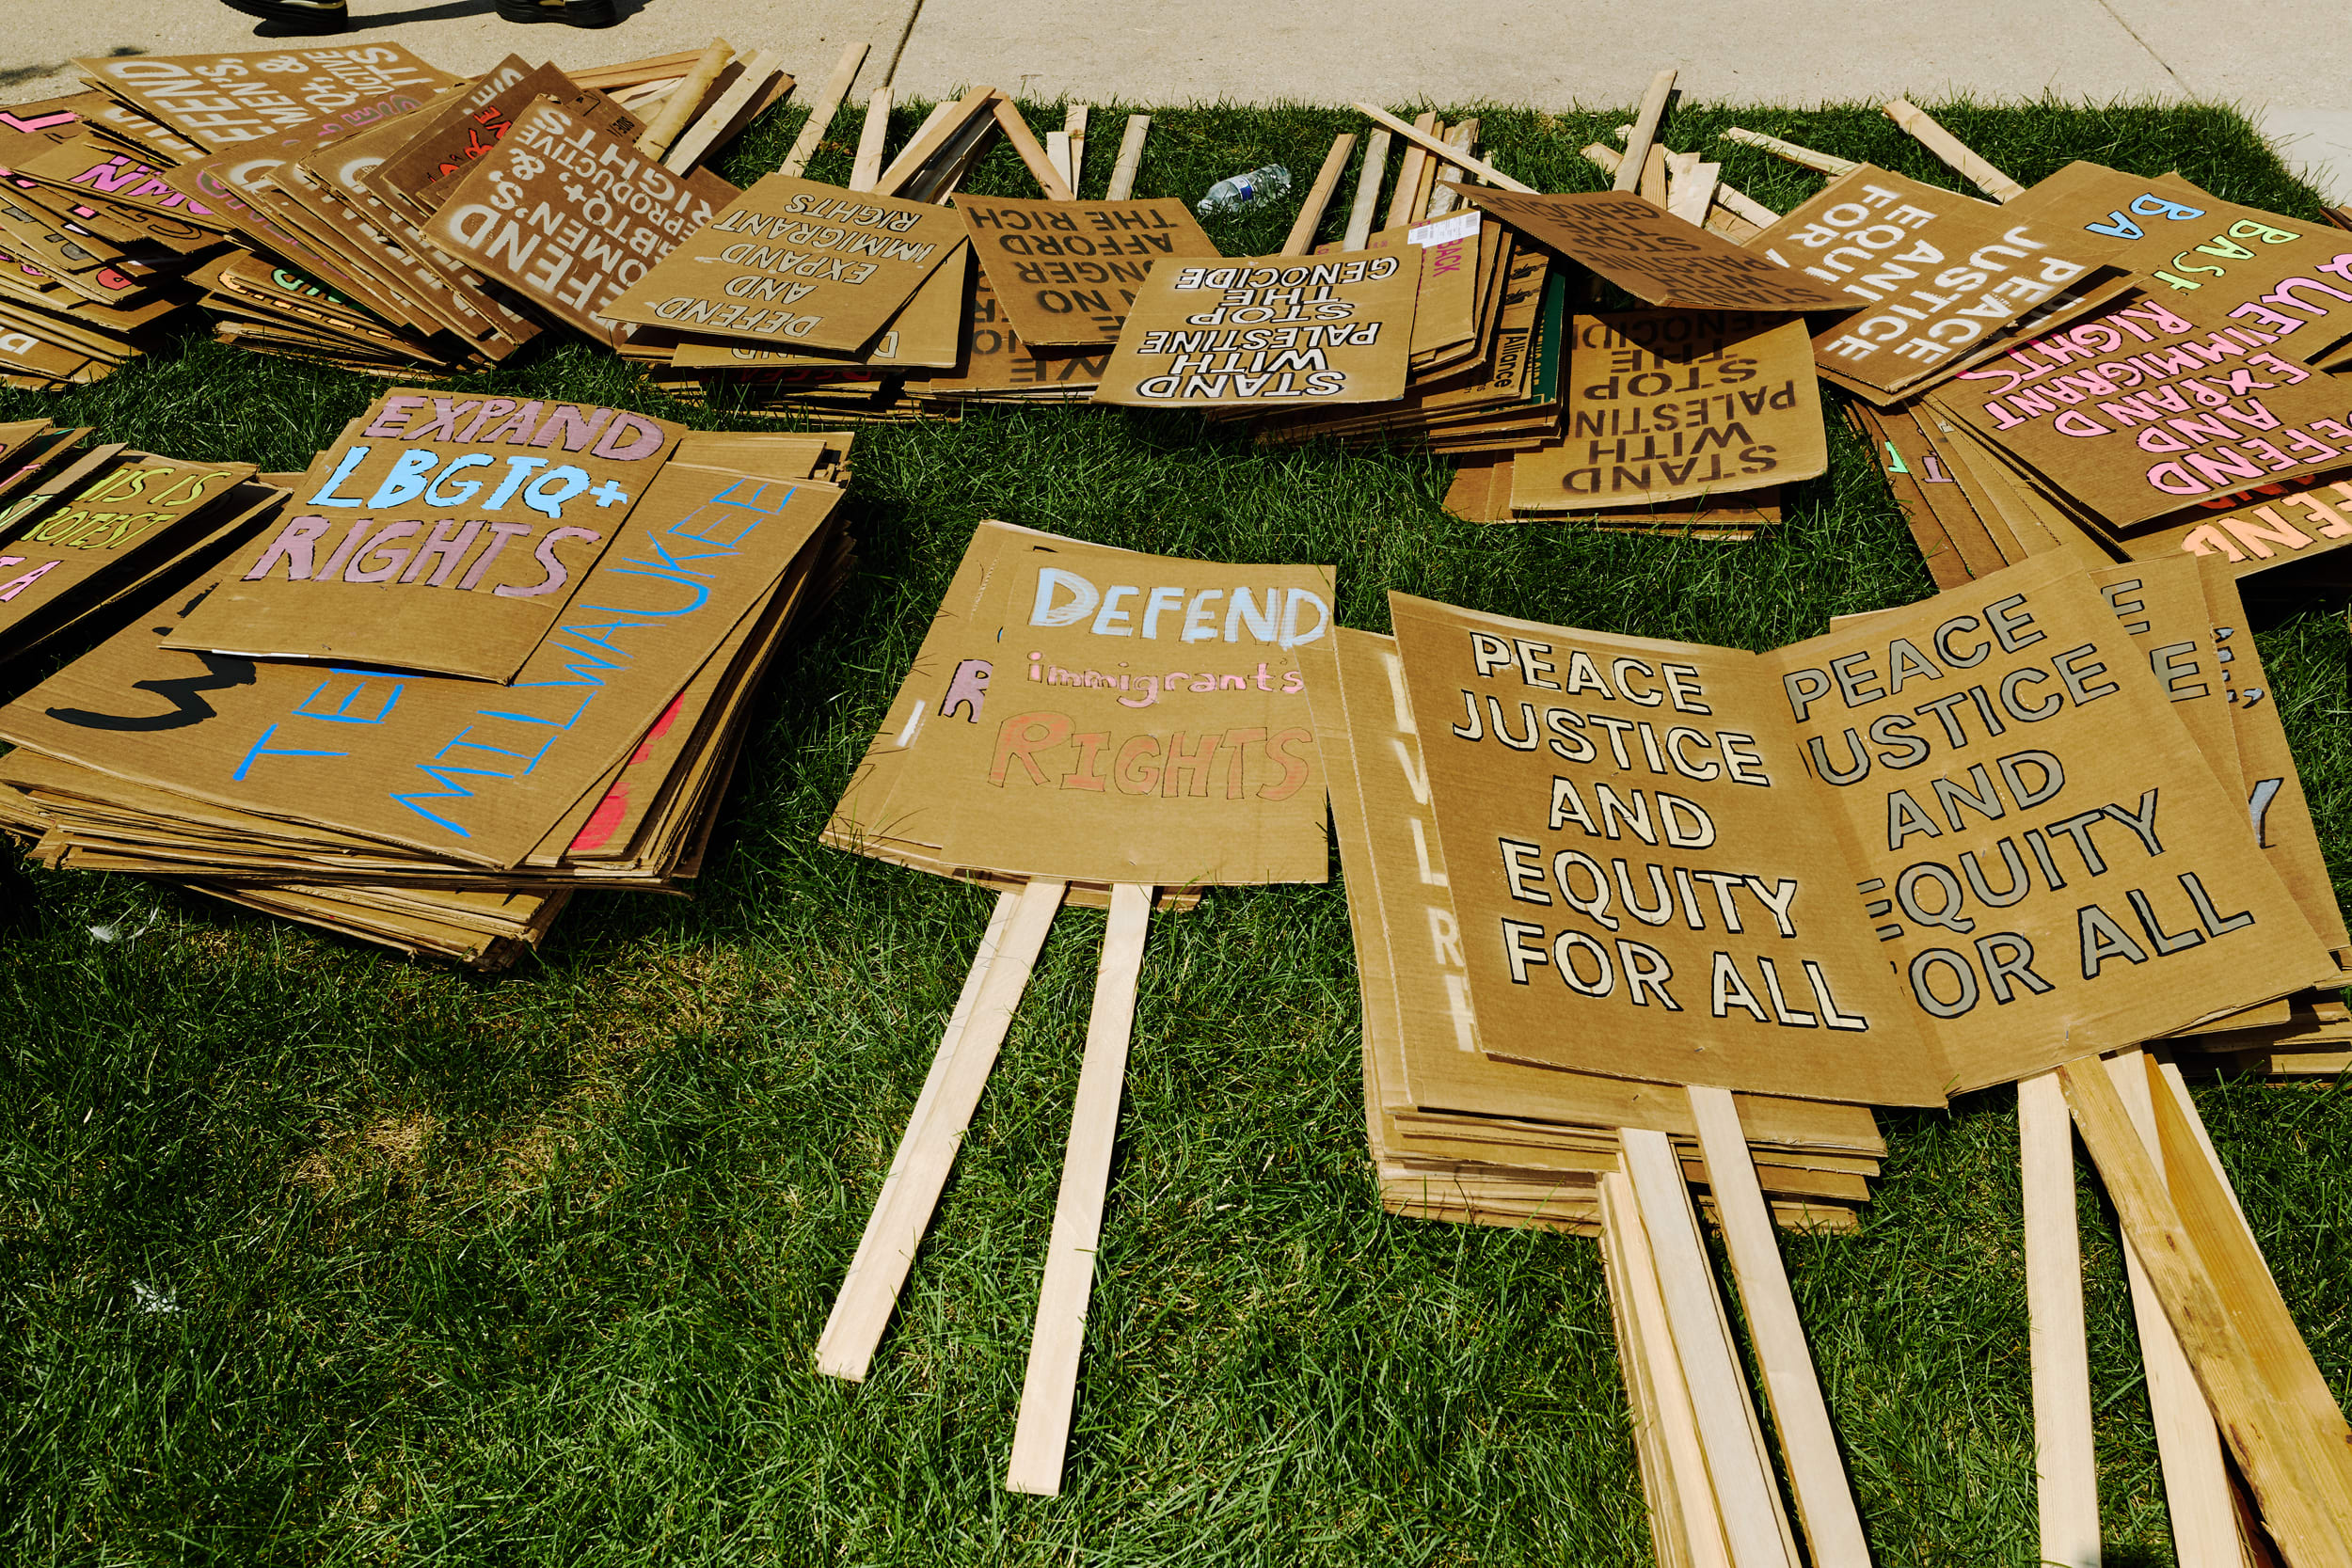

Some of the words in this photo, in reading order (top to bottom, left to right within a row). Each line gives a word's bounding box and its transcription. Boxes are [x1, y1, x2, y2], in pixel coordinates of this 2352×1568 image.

[255, 55, 310, 73] &
[105, 60, 276, 143] EFEND
[508, 148, 546, 182] &
[516, 123, 700, 243] EPRODUCTIVE
[532, 105, 715, 227] RIGHTS
[488, 170, 649, 288] OMEN'S,
[784, 194, 924, 233] RIGHTS
[967, 206, 1079, 232] RICH
[1084, 208, 1179, 231] THE
[1479, 193, 1662, 222] GENOCIDE
[1555, 217, 1661, 239] THE
[1787, 184, 1903, 248] FOR
[2084, 192, 2207, 241] BA
[711, 209, 937, 263] IMMIGRANT
[998, 232, 1175, 257] AFFORD
[1570, 234, 1703, 255] STOP
[1587, 246, 1779, 273] PALESTINE
[1802, 203, 1939, 286] EQUI
[720, 243, 880, 285] EXPAND
[1013, 260, 1155, 285] NGER
[1175, 256, 1400, 290] GENOCIDE
[1640, 271, 1788, 291] WITH
[724, 275, 818, 305] AND
[1035, 290, 1112, 314] NO
[1187, 304, 1356, 325] STOP
[1222, 285, 1343, 307] THE
[1664, 286, 1835, 305] STAND
[1822, 226, 2047, 362] JUSTICE
[1892, 257, 2087, 364] PEACE
[655, 296, 824, 339] DEFEND
[1138, 321, 1382, 355] PALESTINE
[1171, 347, 1330, 375] WITH
[1494, 335, 1529, 388] Alliance
[1582, 357, 1758, 401] STOP
[1610, 339, 1739, 373] THE
[1982, 326, 2263, 432] IMMIGRANT
[1137, 370, 1346, 399] STAND
[1575, 379, 1797, 438] PALESTIN
[2053, 351, 2312, 438] EXPAND
[361, 395, 666, 462] EXPAND
[1588, 421, 1756, 465] WITH
[2136, 396, 2284, 453] AND
[1562, 444, 1778, 494] STAND
[2146, 411, 2352, 496] EFEND
[148, 470, 233, 507] IS
[306, 446, 629, 519] LBGTQ+
[20, 506, 179, 550] ROTEST
[239, 515, 602, 598] RIGHTS
[1026, 565, 1331, 650] DEFEND
[389, 474, 800, 838] MILWAUKEE
[1470, 631, 1712, 716] PEACE
[1783, 593, 2047, 723] PEACE
[1452, 689, 1771, 787] JUSTICE
[1796, 643, 2120, 787] USTICE
[987, 710, 1316, 802] RIGHTS
[1549, 776, 1716, 849] AND
[1886, 749, 2066, 851] AND
[1498, 837, 1798, 939] EQUITY
[1890, 931, 2056, 1020] OR
[2076, 871, 2256, 981] ALL
[1501, 917, 1685, 1012] FOR
[1711, 951, 1869, 1033] ALL
